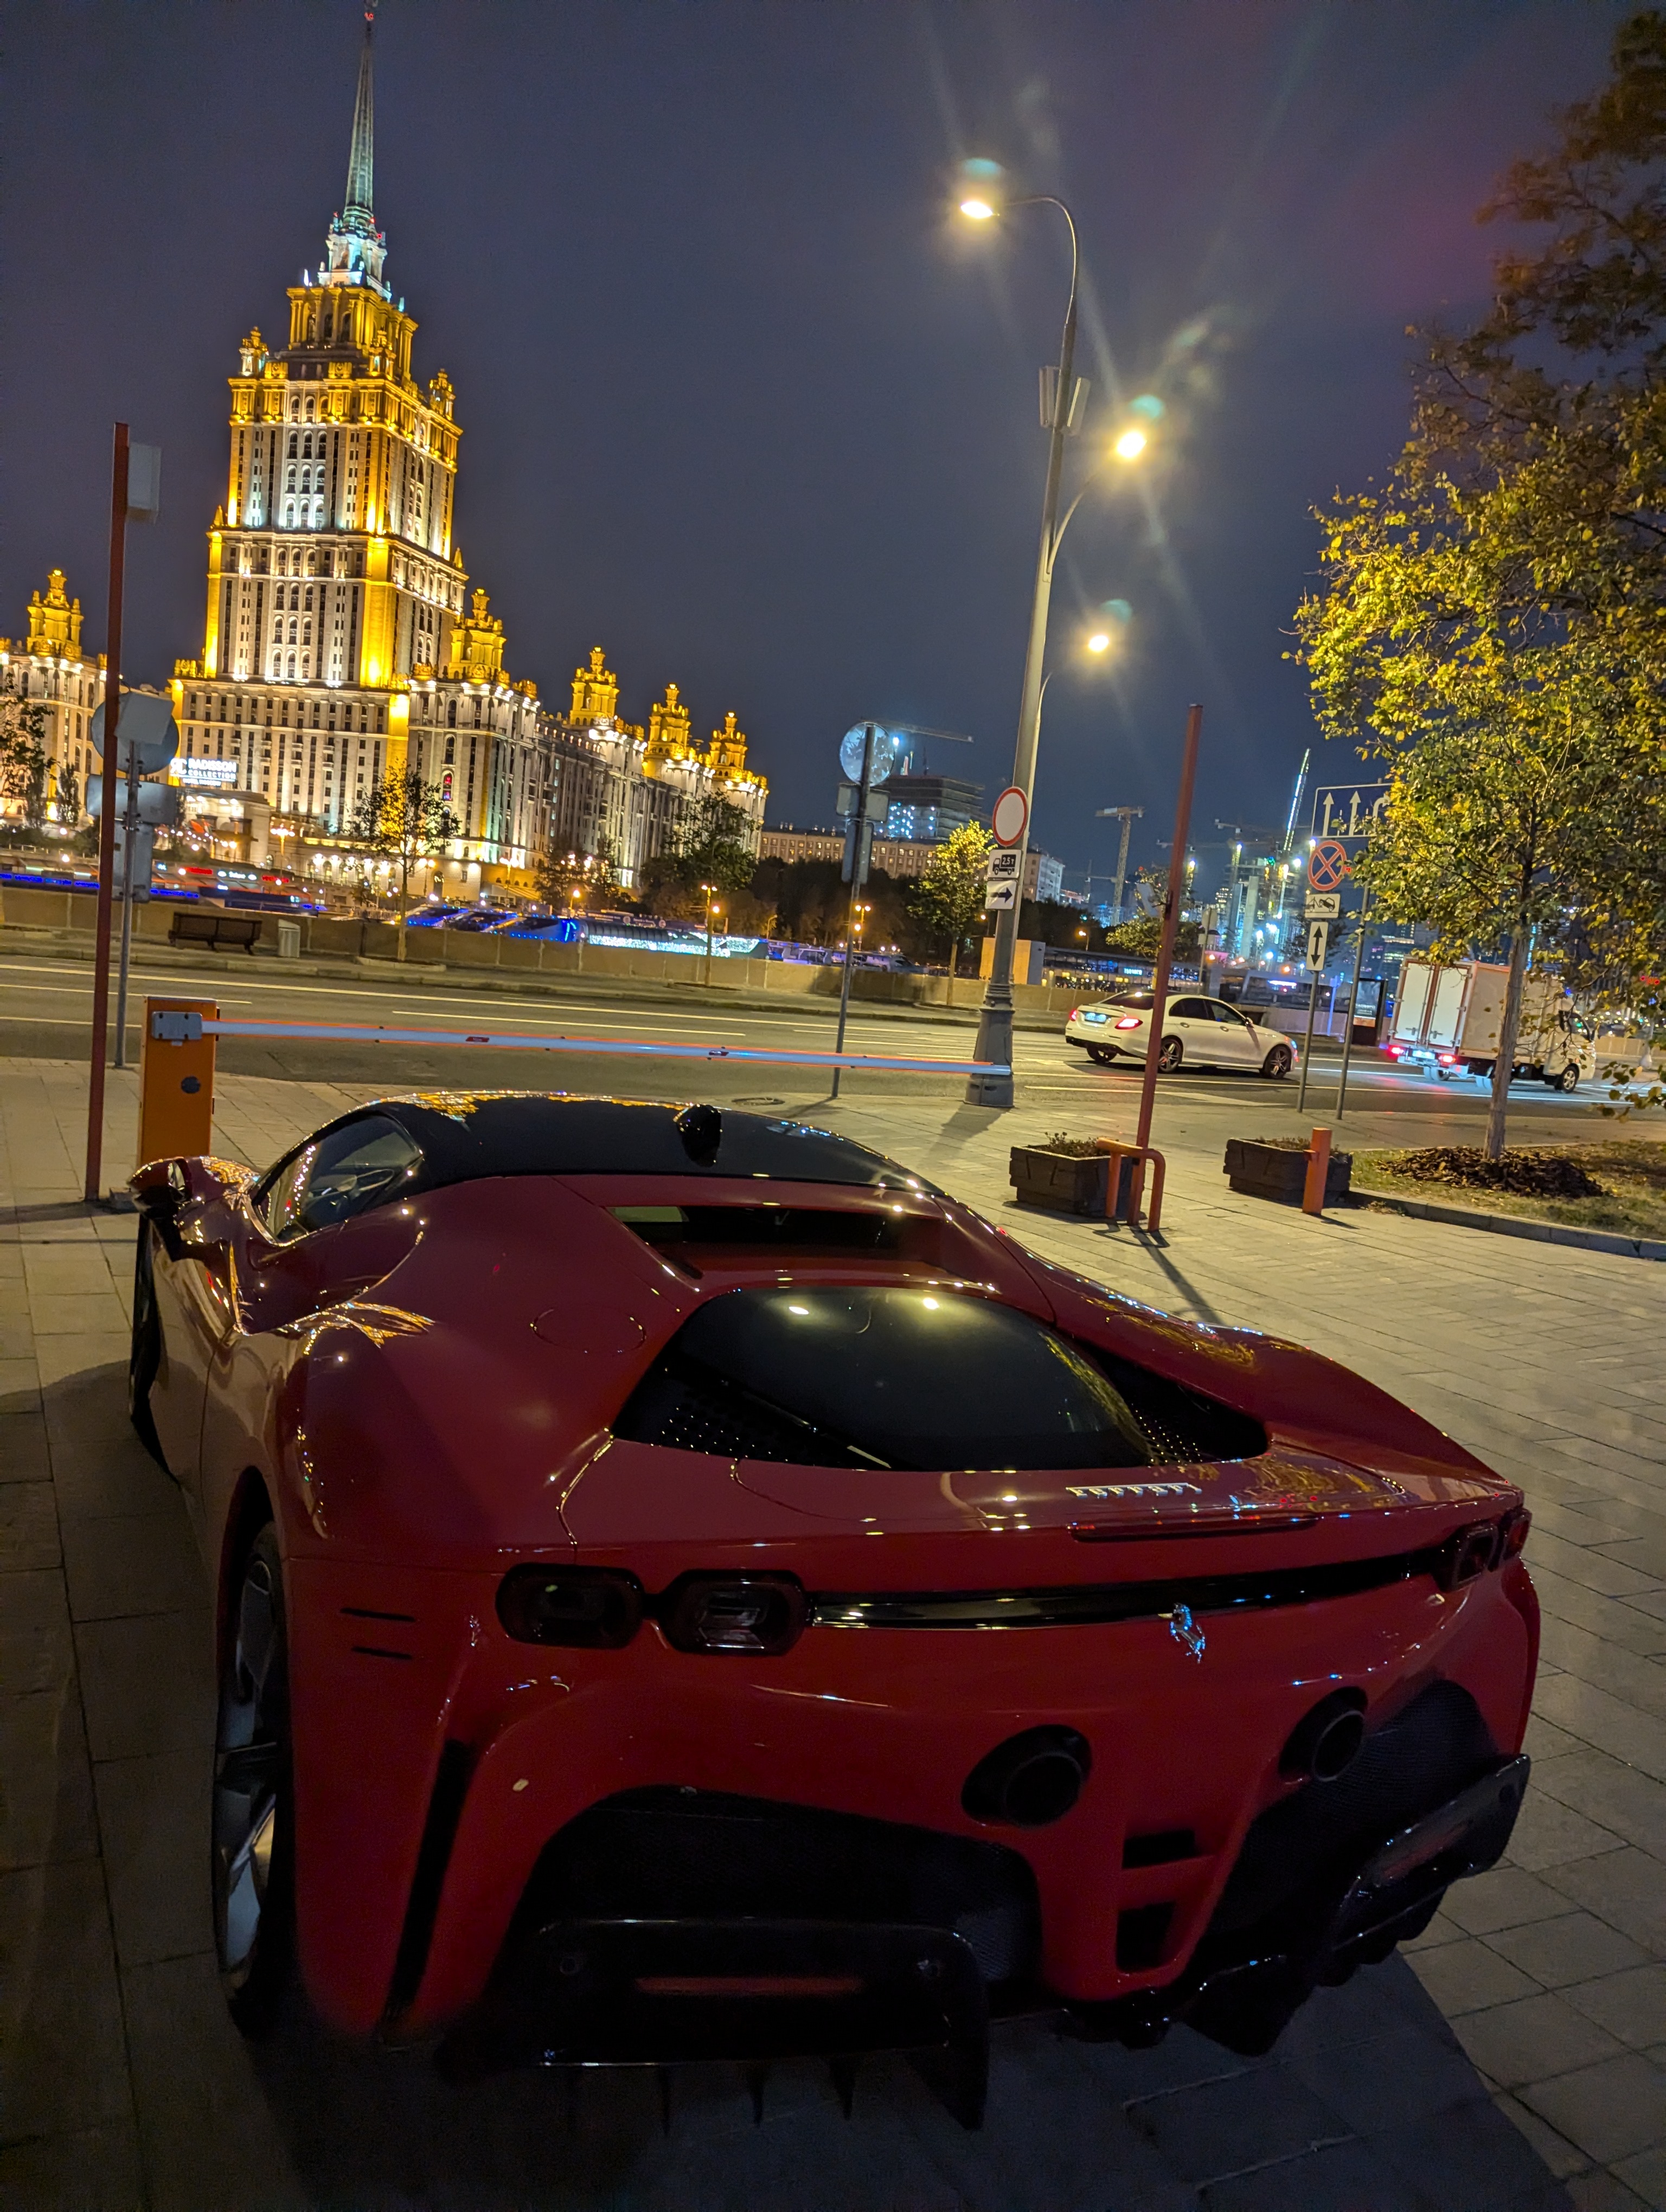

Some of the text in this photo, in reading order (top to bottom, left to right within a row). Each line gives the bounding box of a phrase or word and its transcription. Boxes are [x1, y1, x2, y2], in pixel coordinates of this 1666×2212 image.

[188, 758, 237, 773] RADISSON
[188, 769, 236, 780] COLLECTION
[1065, 1482, 1202, 1499] Ferrari
